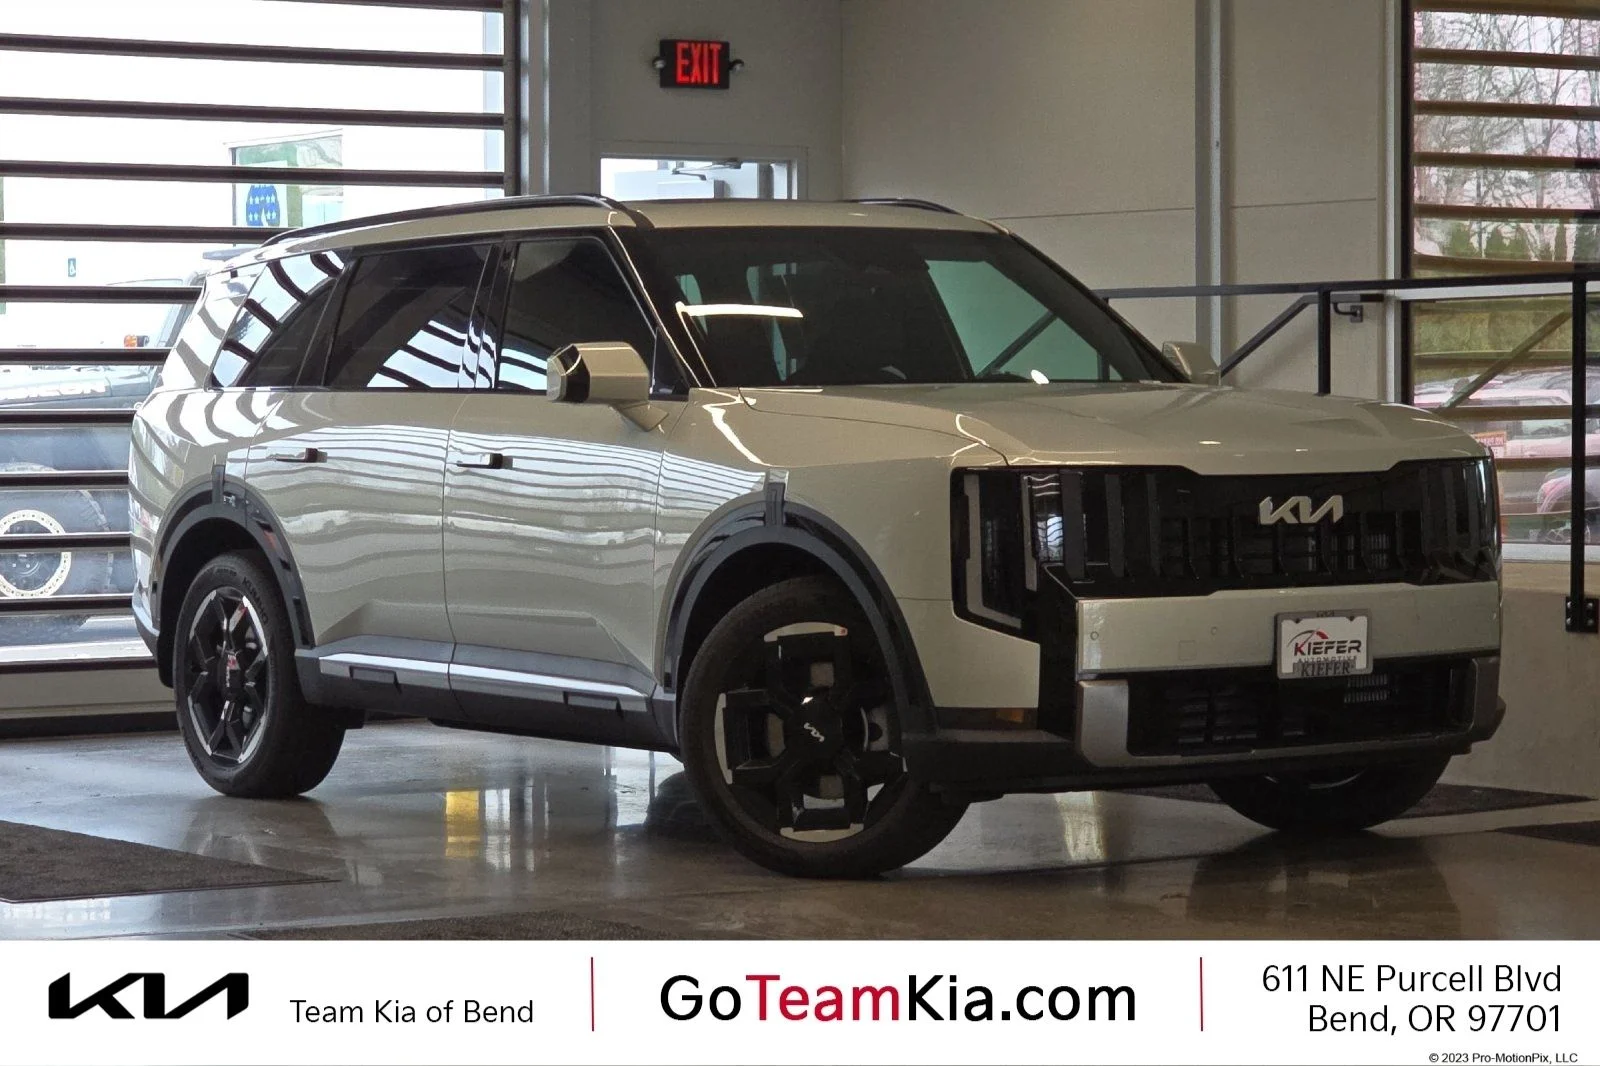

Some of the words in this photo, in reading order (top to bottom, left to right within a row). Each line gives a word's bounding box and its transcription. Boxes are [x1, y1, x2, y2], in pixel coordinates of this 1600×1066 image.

[676, 42, 722, 84] EXIT
[1259, 494, 1344, 525] KIA
[1294, 639, 1362, 656] KIEFER
[1301, 661, 1351, 677] KIEFER
